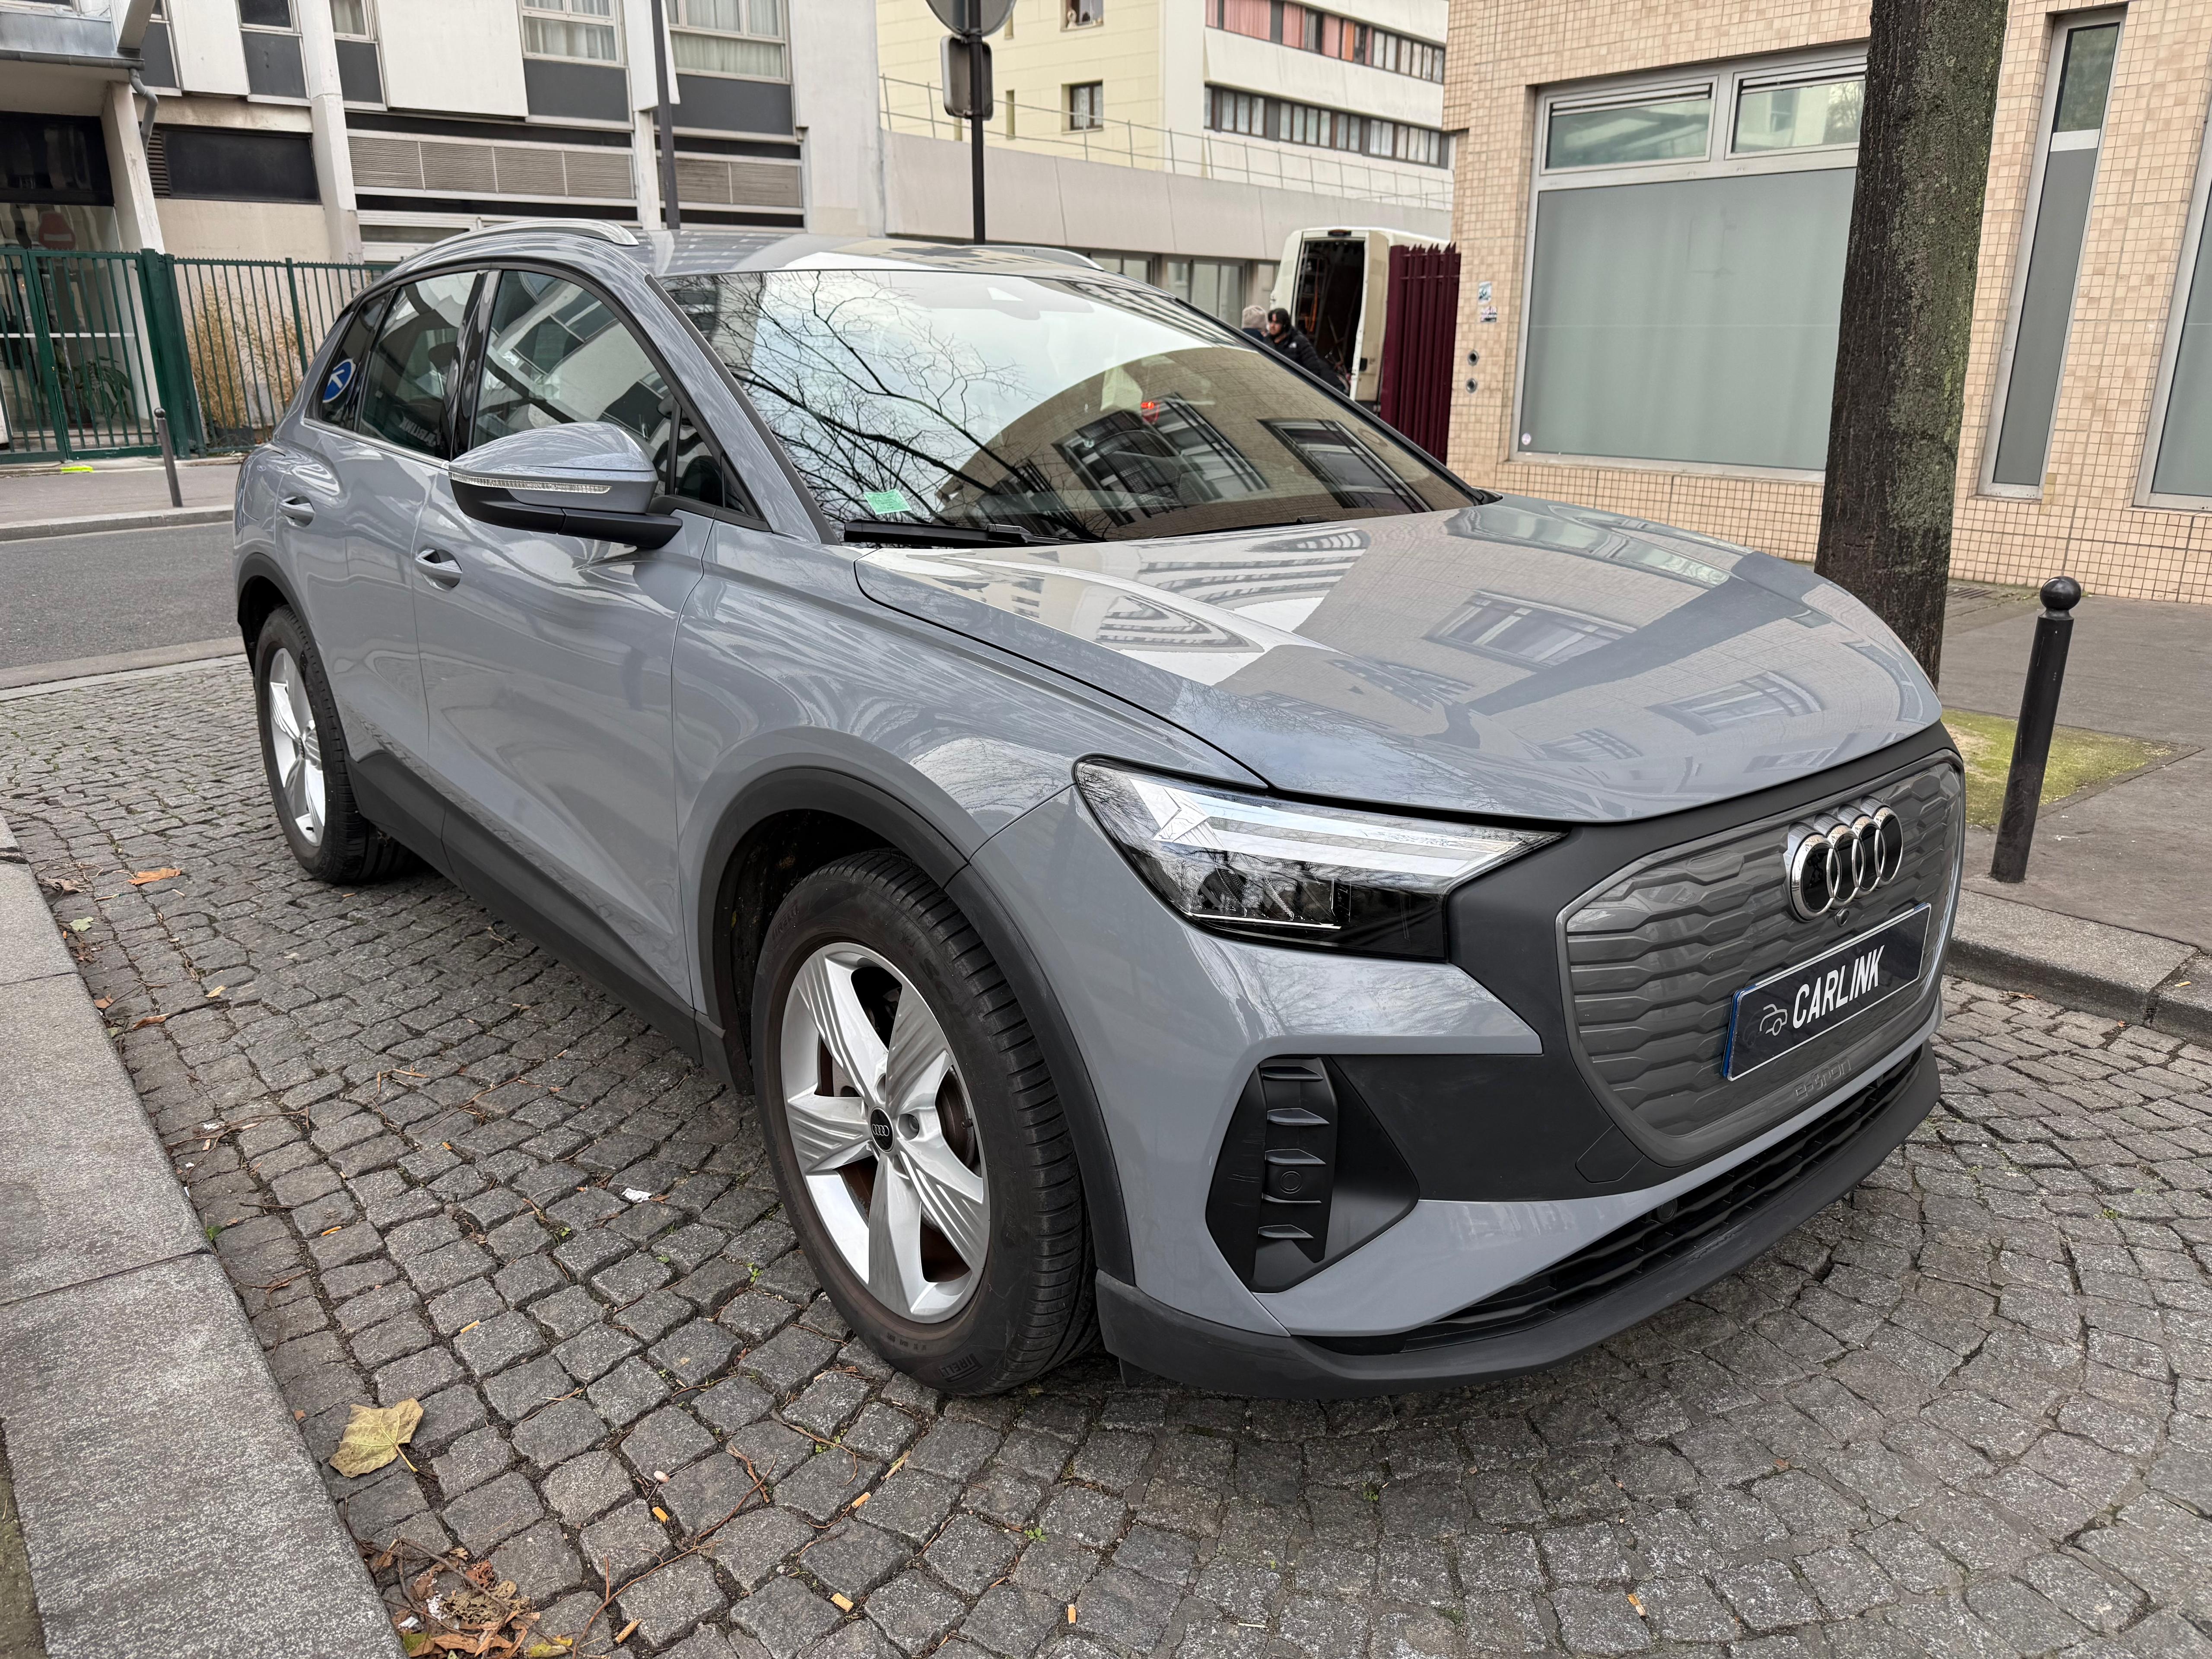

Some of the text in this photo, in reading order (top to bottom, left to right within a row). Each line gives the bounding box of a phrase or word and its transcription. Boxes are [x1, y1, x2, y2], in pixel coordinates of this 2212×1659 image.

[1793, 945, 1885, 1029] CARLINK
[1793, 1057, 1851, 1101] e-tron
[937, 1353, 983, 1382] PIRELLI
